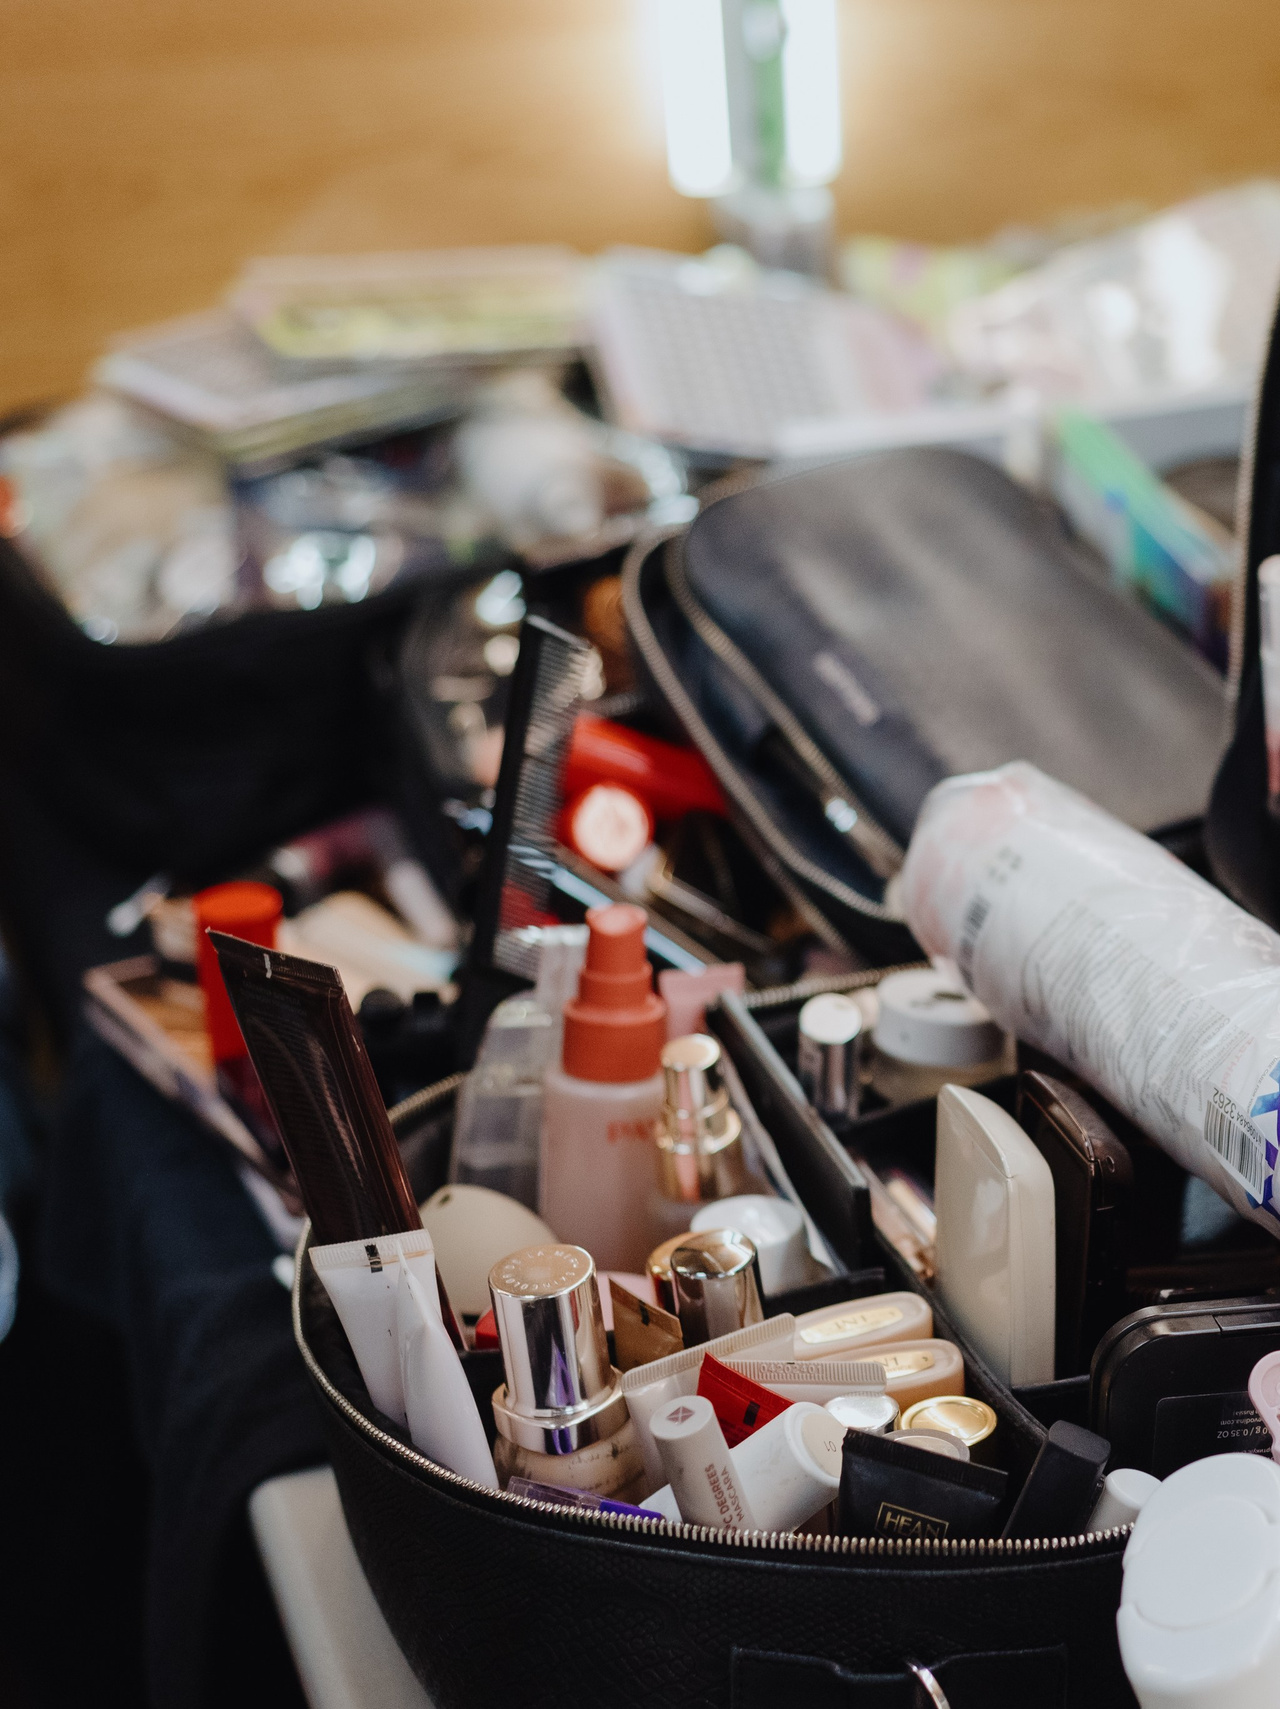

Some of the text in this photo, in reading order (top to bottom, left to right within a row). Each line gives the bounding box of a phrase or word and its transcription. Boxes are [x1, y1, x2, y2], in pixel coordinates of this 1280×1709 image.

[1212, 1086, 1237, 1119] 3262
[1217, 1430, 1229, 1439] OZ
[704, 1463, 730, 1515] DEGREES
[721, 1466, 745, 1521] MASCARA
[884, 1511, 940, 1540] HEAN
